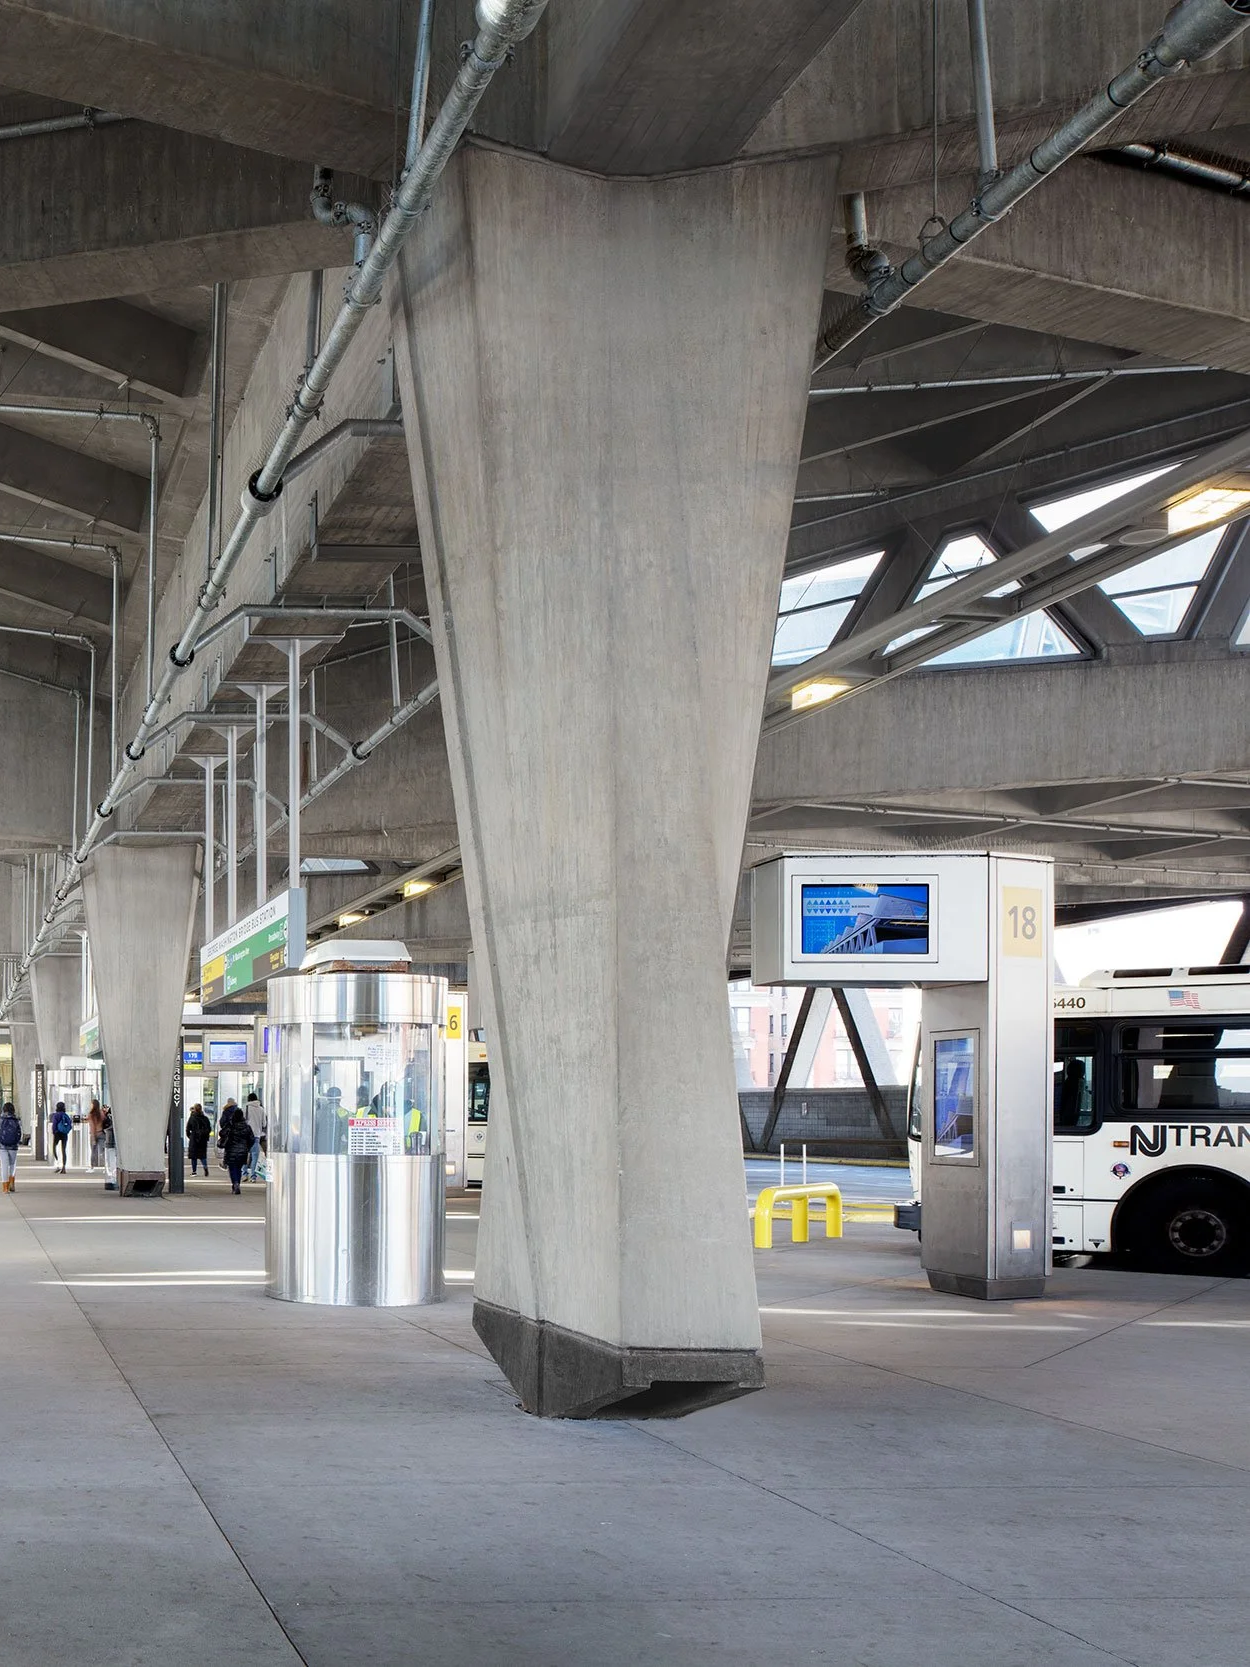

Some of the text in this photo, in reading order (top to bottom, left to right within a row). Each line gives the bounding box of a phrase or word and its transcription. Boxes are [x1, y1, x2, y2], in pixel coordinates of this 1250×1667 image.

[1008, 905, 1037, 940] 18
[1053, 997, 1086, 1009] 440
[1130, 1124, 1250, 1158] NJ TRAN
